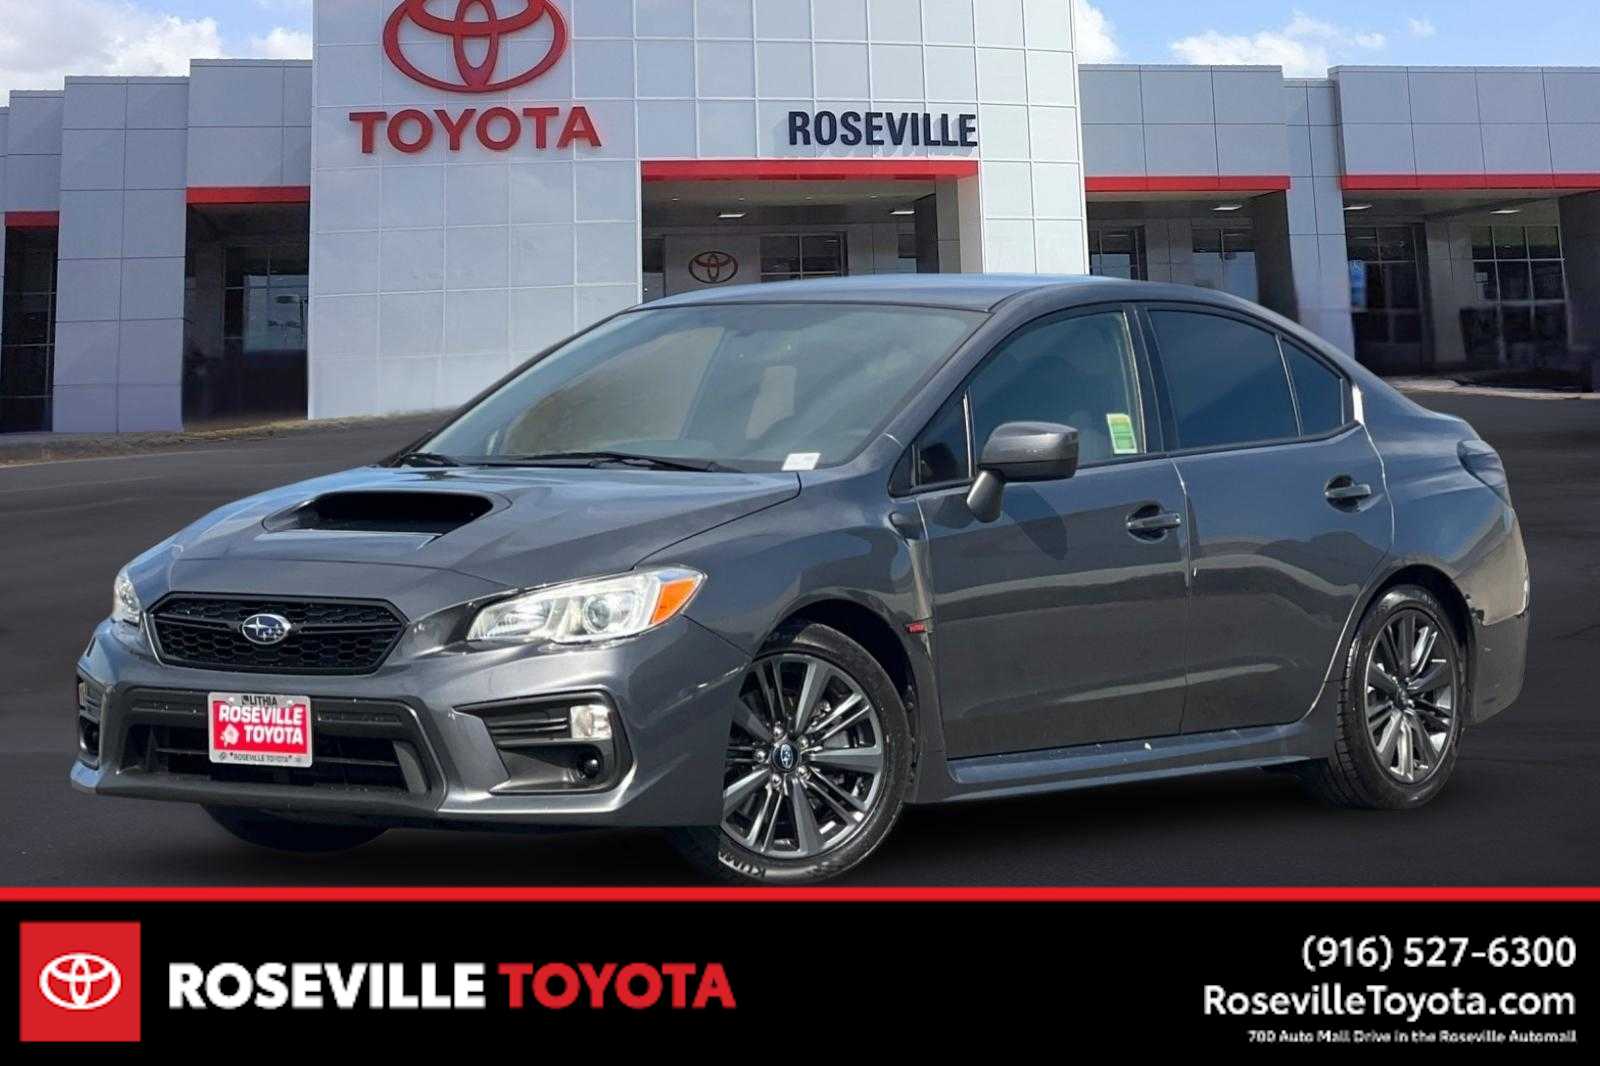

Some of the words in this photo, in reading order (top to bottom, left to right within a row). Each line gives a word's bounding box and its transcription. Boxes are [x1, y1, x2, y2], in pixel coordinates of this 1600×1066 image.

[350, 106, 602, 154] TOYOTA
[788, 110, 978, 148] ROSEVILLE
[249, 695, 278, 706] LITHIA
[219, 705, 303, 724] ROSEVILLE
[244, 724, 304, 744] TOYOTA
